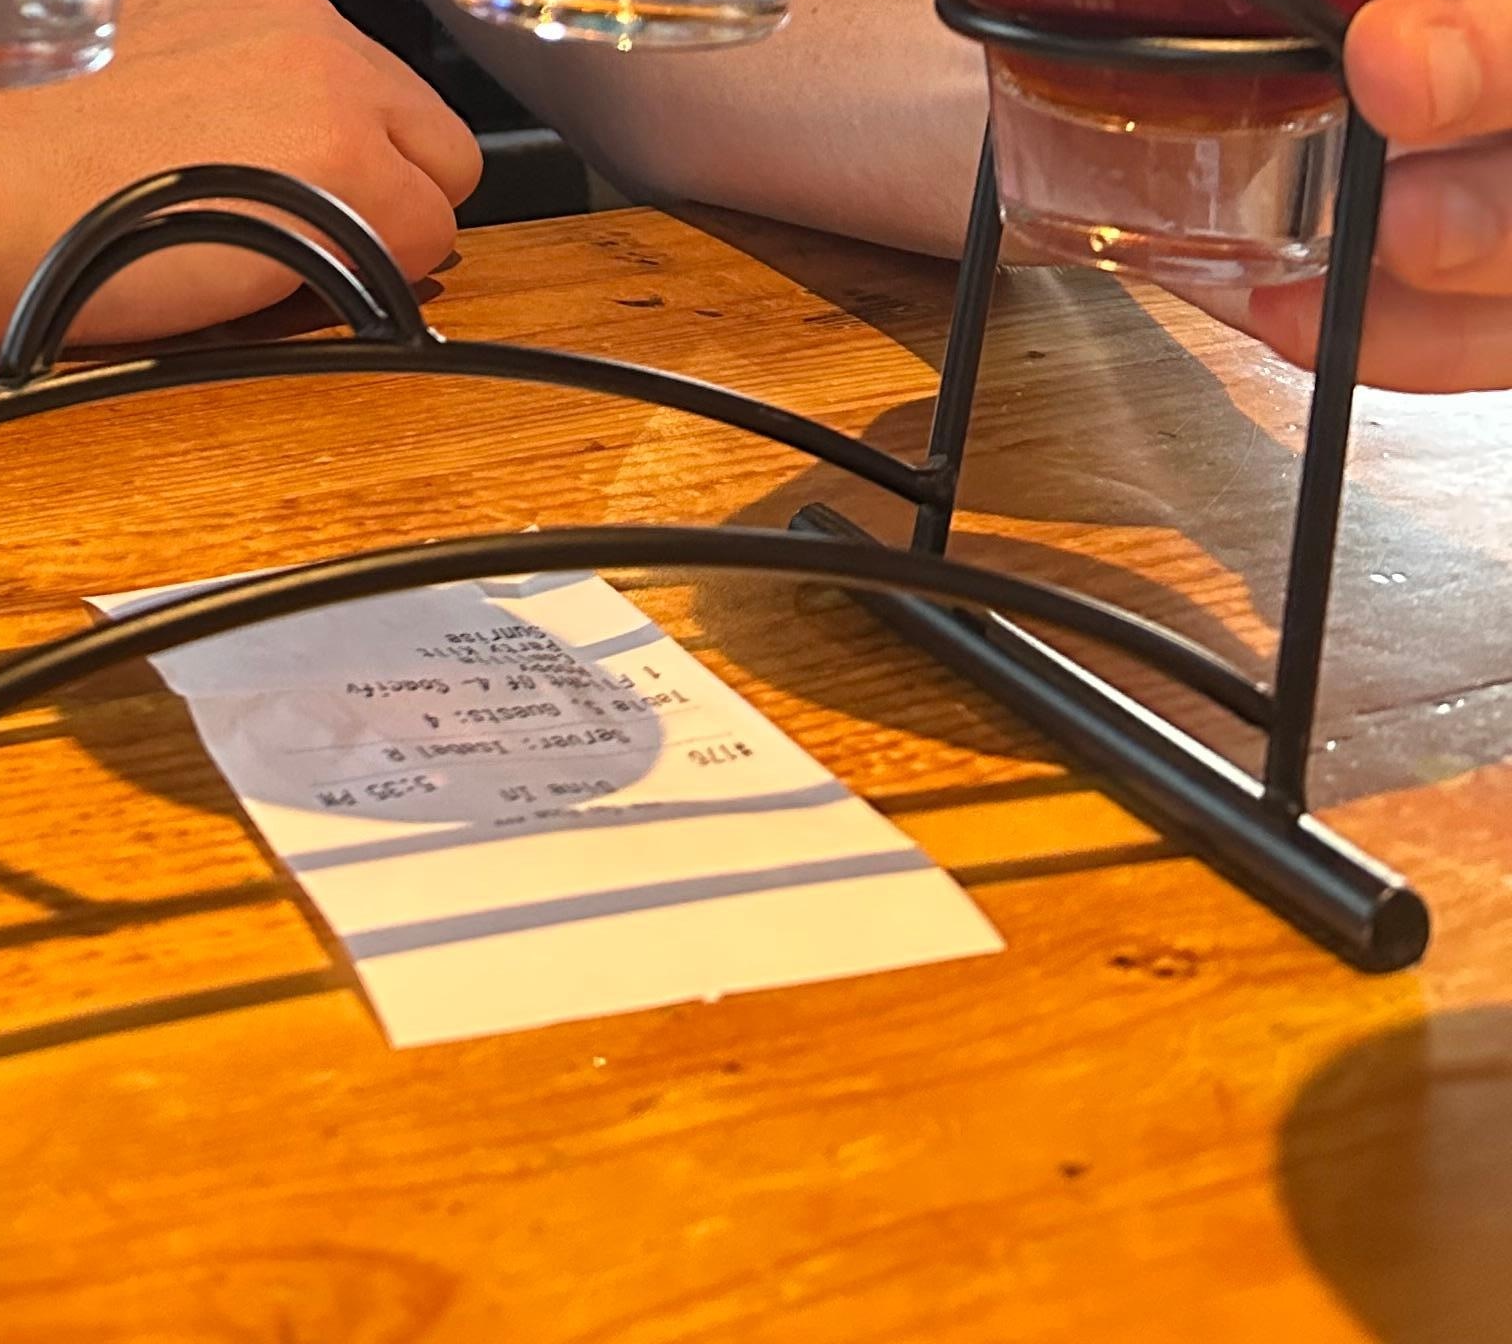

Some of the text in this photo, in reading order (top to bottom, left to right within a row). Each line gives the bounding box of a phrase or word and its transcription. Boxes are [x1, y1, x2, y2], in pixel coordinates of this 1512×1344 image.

[444, 625, 547, 644] Sunrise
[612, 689, 690, 712] Table
[454, 702, 561, 724] Guests:
[522, 728, 630, 750] Server:
